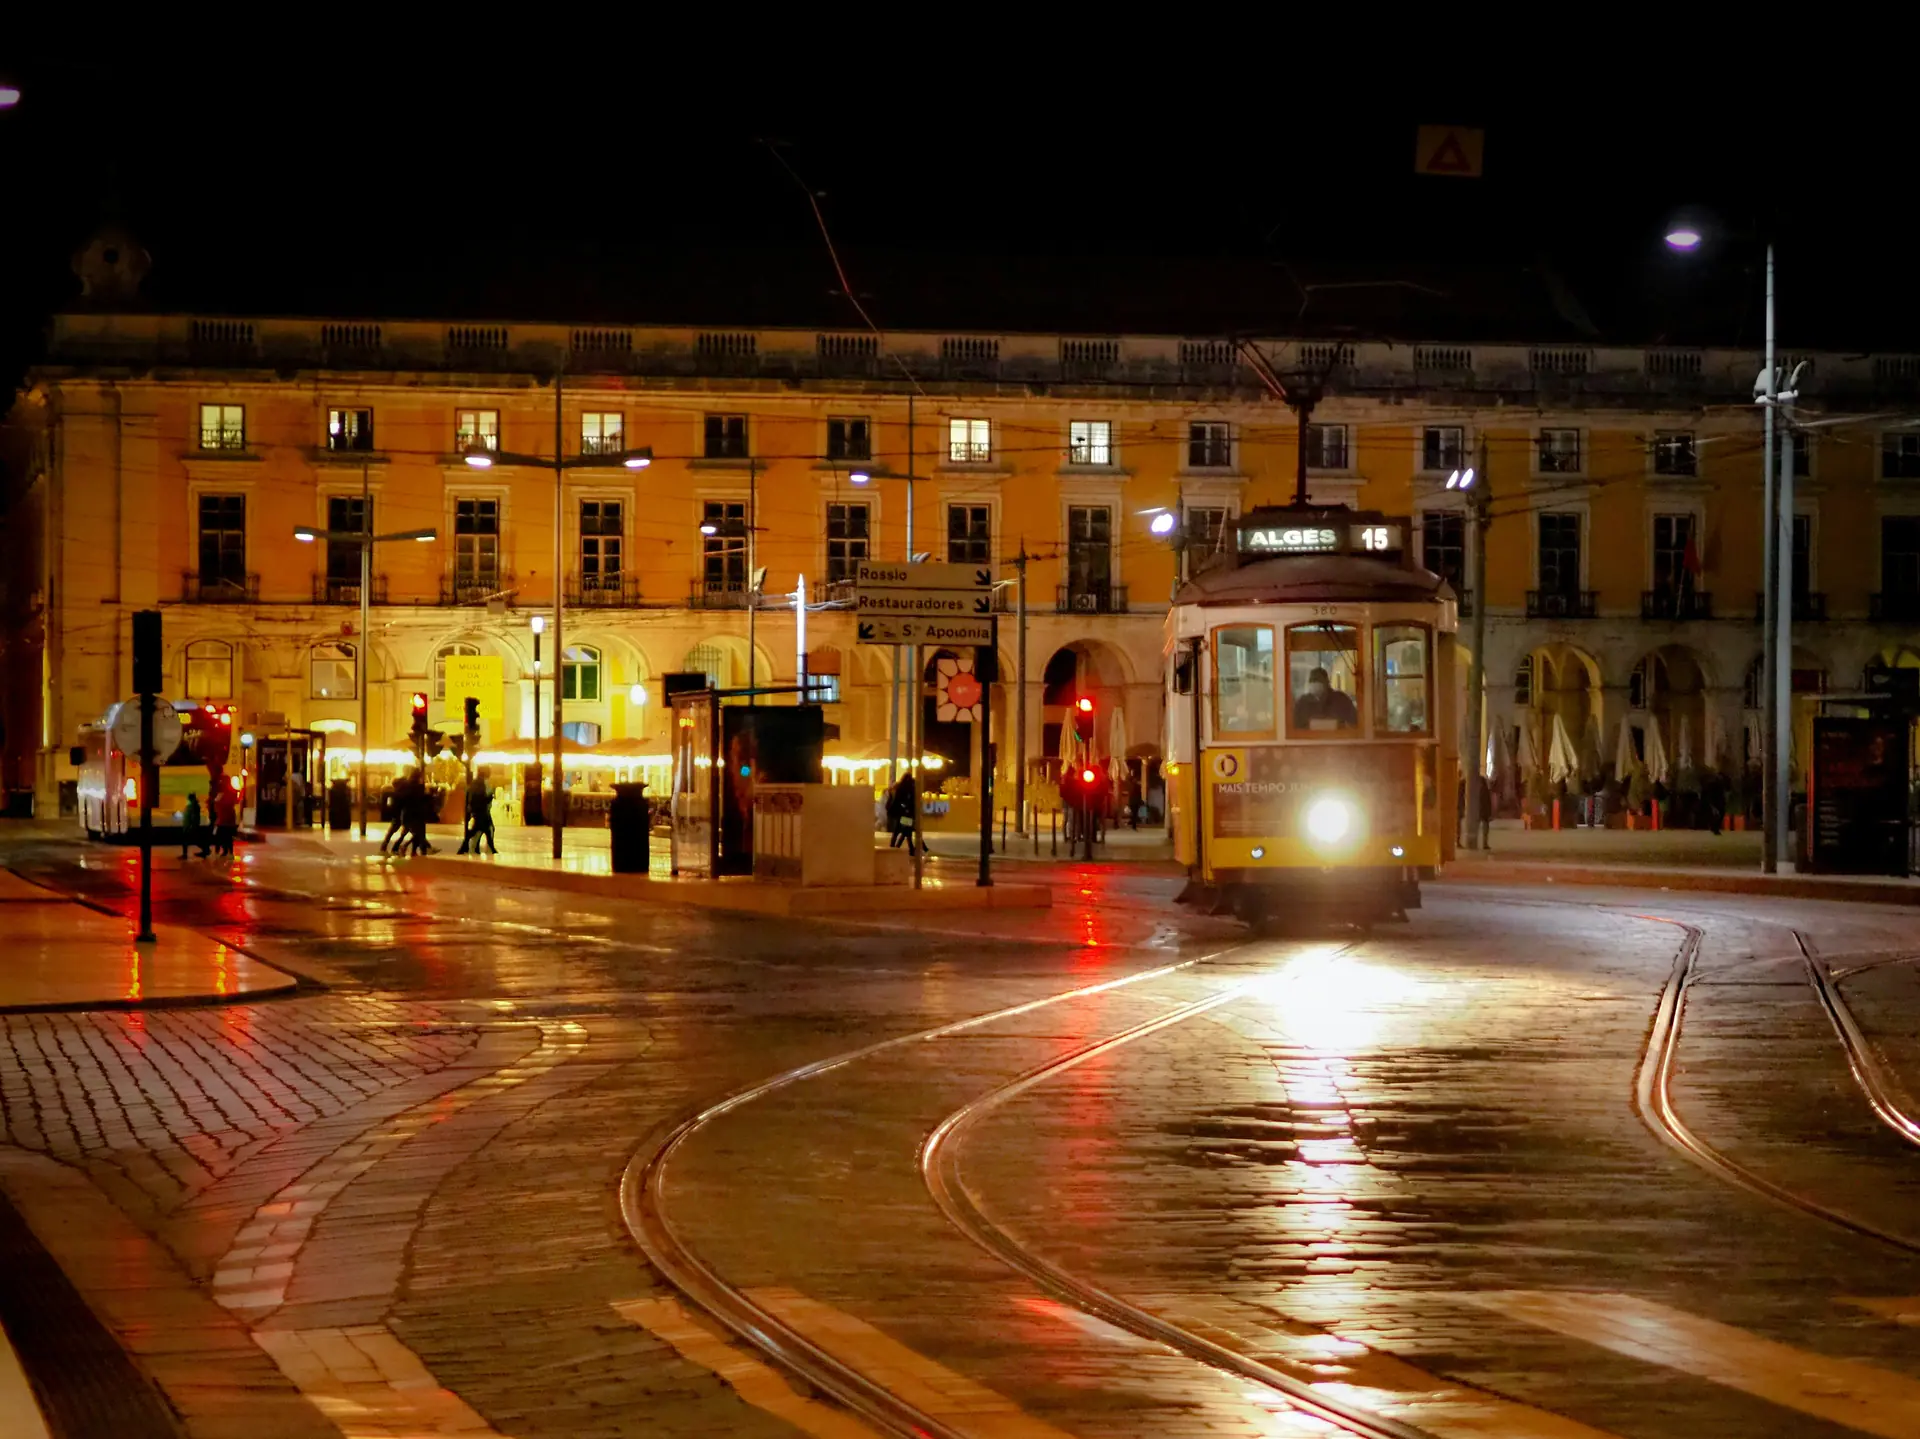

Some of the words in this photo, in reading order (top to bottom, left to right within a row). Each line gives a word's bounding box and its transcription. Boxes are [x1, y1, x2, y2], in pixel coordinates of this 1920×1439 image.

[1361, 527, 1388, 550] 15
[860, 567, 908, 581] Rossio
[859, 595, 965, 610] Restauradores
[454, 680, 493, 688] CERVEJA
[1219, 783, 1242, 793] MAIS
[1245, 782, 1286, 794] TEMPO
